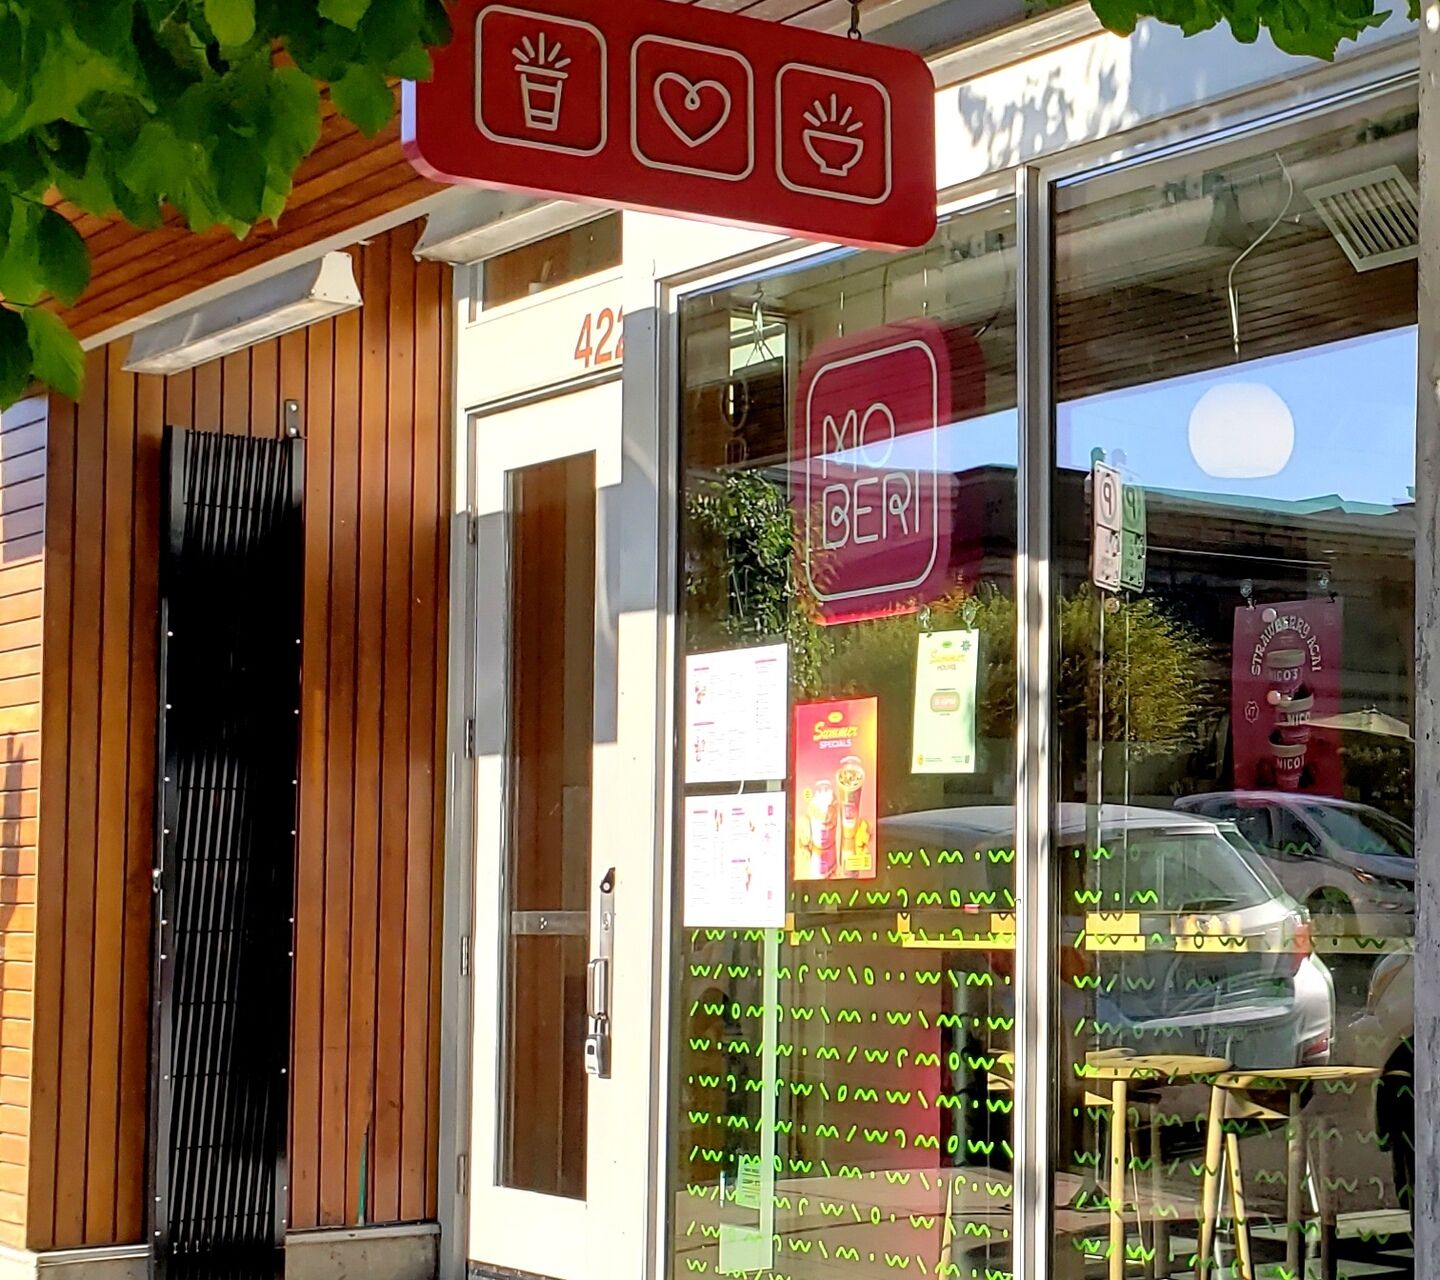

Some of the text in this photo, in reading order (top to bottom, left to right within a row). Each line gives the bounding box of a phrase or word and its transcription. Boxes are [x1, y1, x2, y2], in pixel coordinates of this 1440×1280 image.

[822, 402, 896, 479] MO
[822, 469, 920, 550] BERI
[1250, 615, 1311, 676] STRAWBERRY
